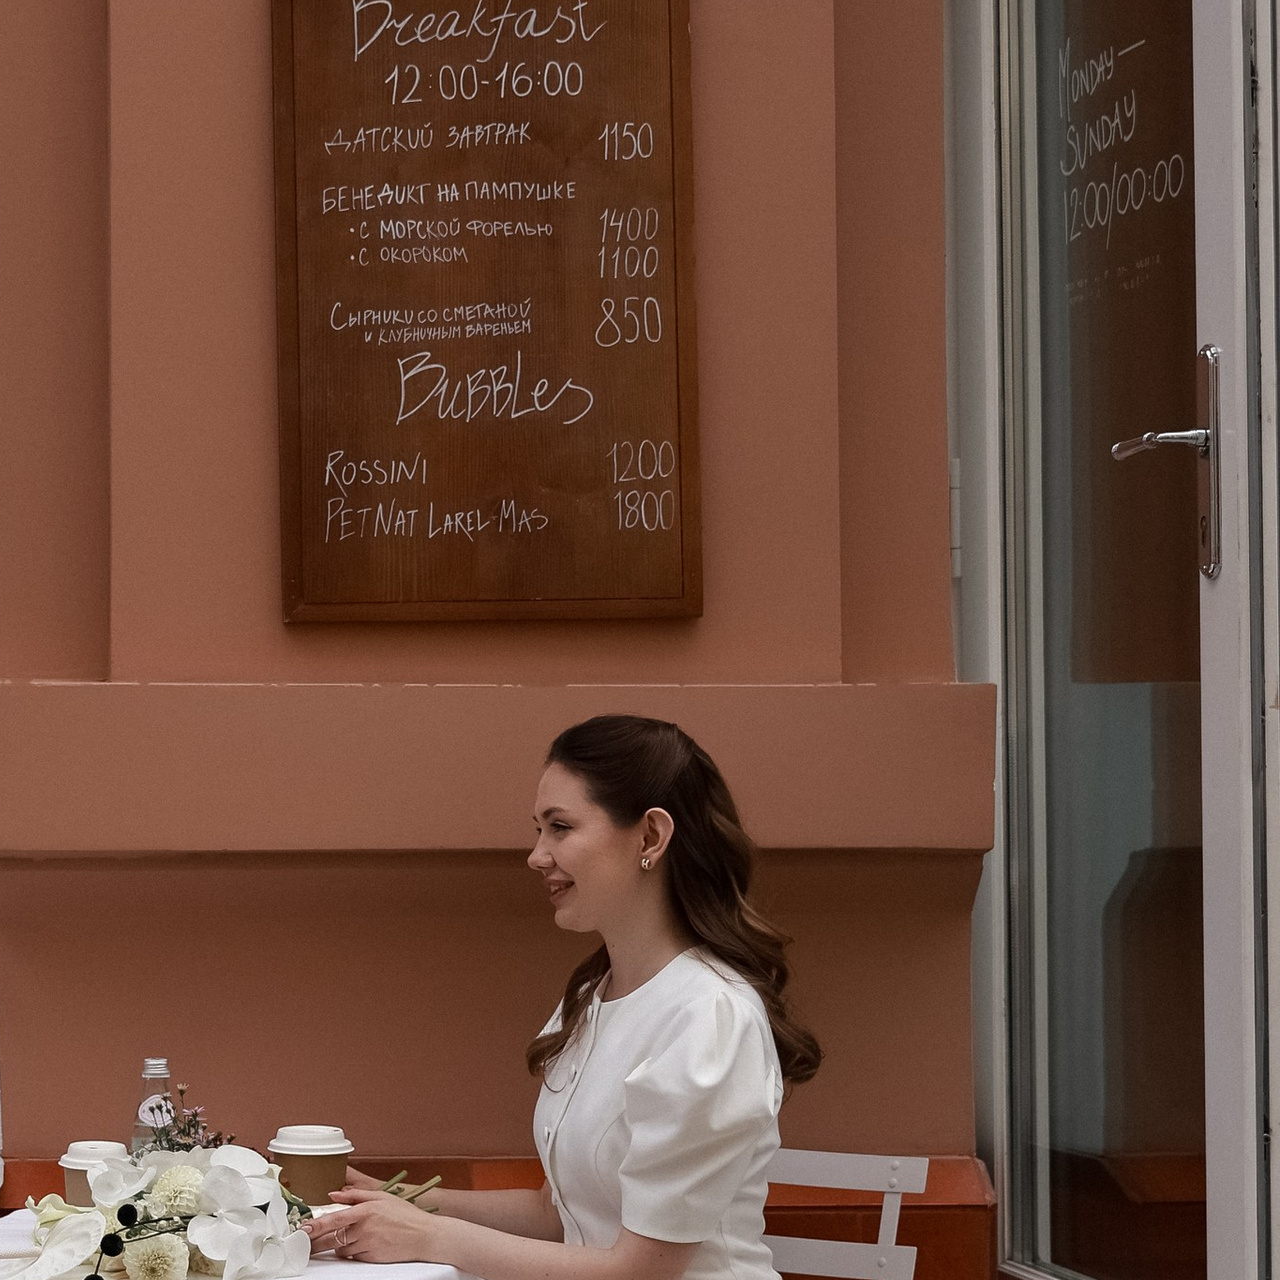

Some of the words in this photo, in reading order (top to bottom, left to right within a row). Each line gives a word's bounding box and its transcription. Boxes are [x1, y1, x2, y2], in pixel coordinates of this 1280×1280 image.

[384, 60, 584, 106] 12:00-16:00
[324, 122, 434, 155] ДАТСКИЙ
[445, 121, 532, 150] ЗАВТРАК
[598, 122, 654, 161] 1150
[1060, 88, 1136, 176] SUNDAY
[322, 182, 432, 215] БЕНЕДИКТ
[436, 182, 460, 203] НА
[464, 181, 577, 201] ПАМПУШКЕ
[379, 218, 461, 240] МОРСКОЙ
[465, 220, 554, 238] ФОРЕЛЬЮ
[599, 206, 659, 243] 1400
[379, 246, 469, 264] ОКОРОКОМ
[598, 245, 659, 279] 1100
[378, 325, 462, 346] КЛУБНИЧНЫМ
[464, 319, 532, 339] ВАРЕНЬЕМ
[442, 297, 532, 322] СМЕТАНОЙ
[595, 296, 662, 348] 850
[605, 439, 675, 484] 1200
[613, 489, 675, 532] 1800
